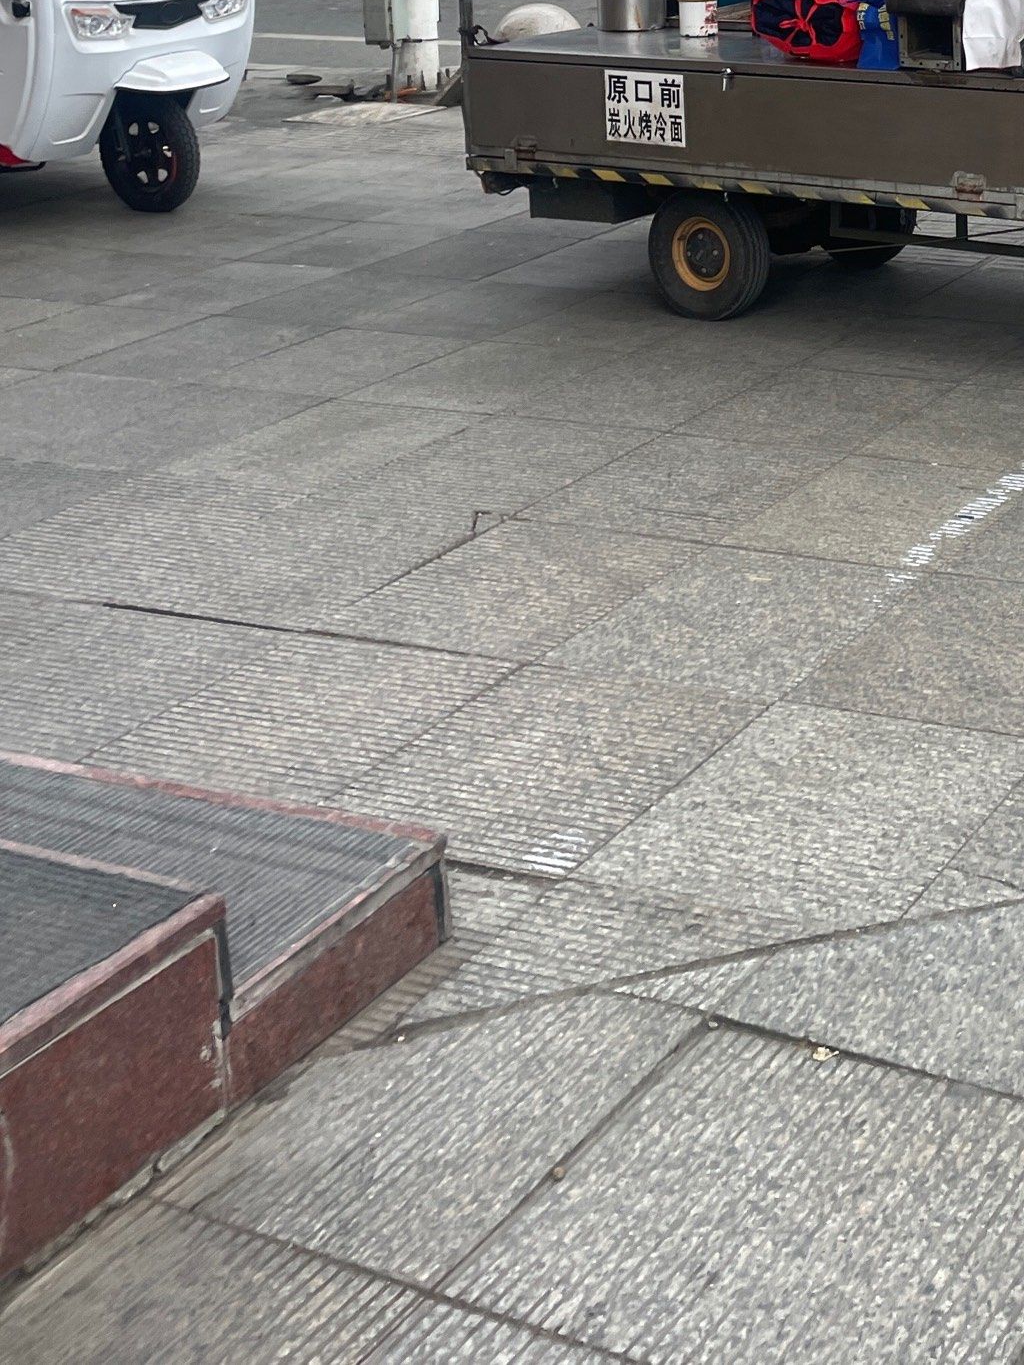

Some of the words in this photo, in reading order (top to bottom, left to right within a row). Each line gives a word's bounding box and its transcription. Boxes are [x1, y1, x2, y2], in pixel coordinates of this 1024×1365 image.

[606, 75, 682, 109] 原口前
[607, 108, 683, 143] 炭火烤冷面
